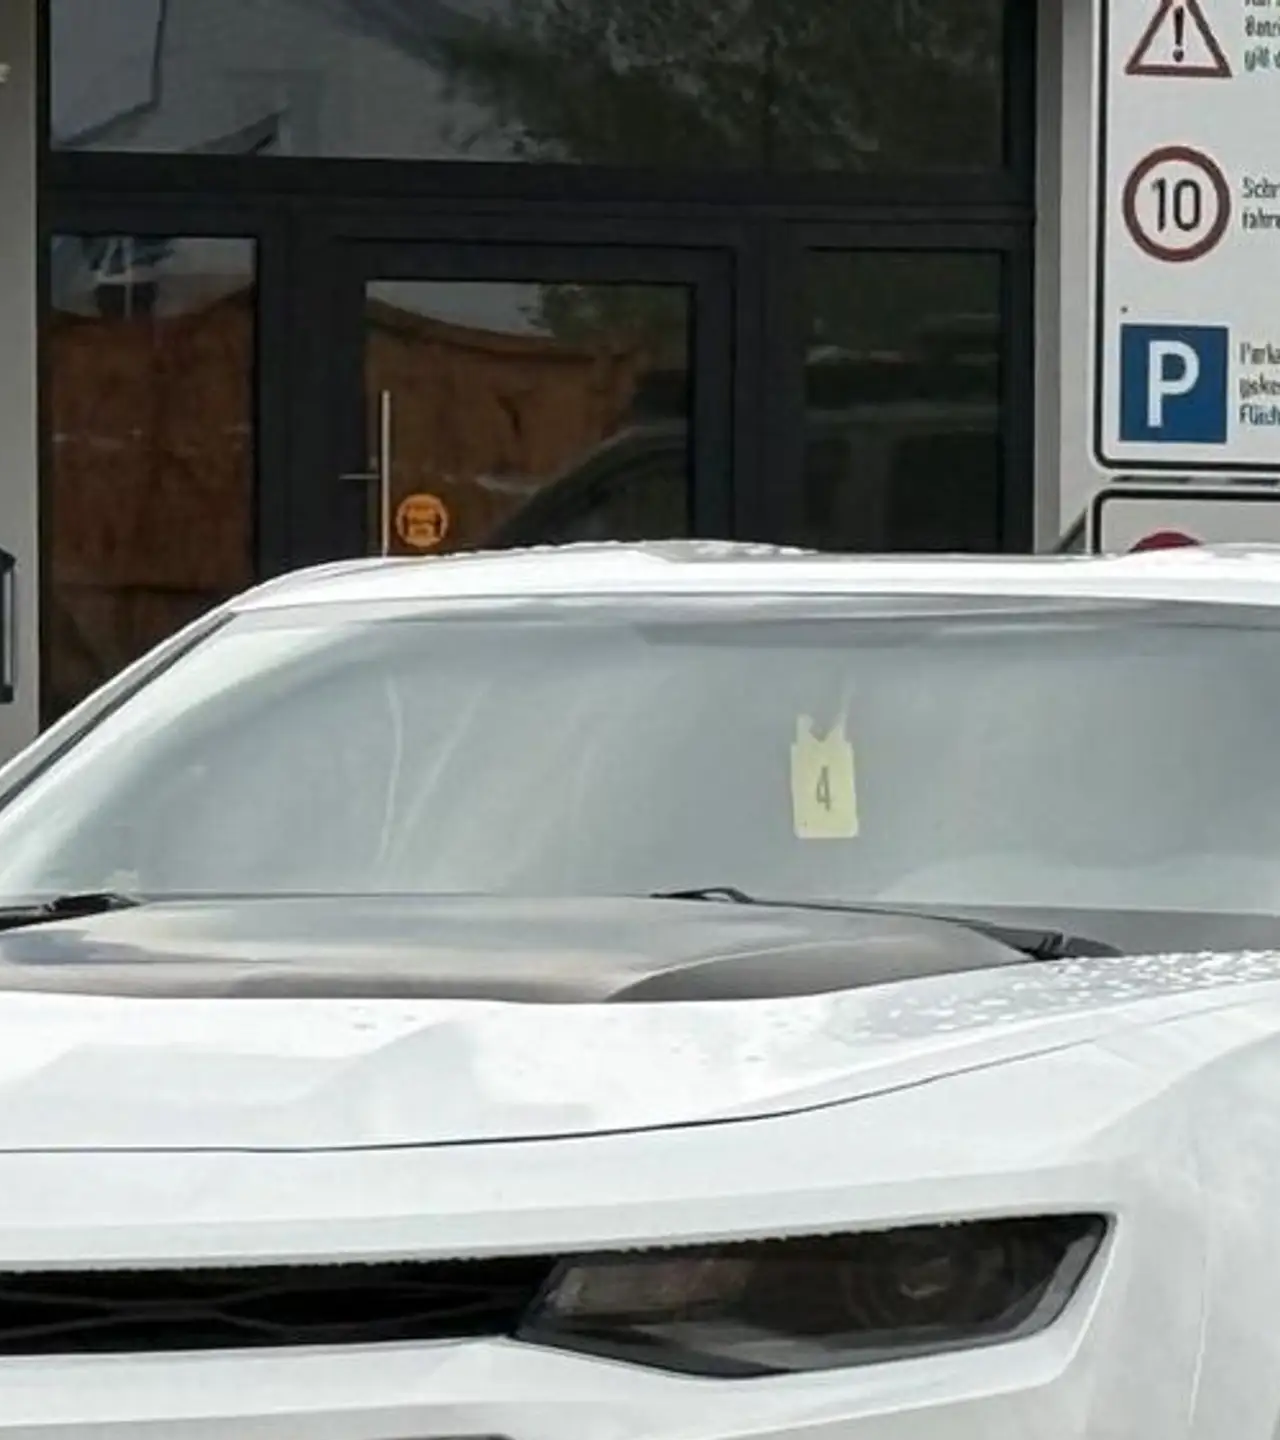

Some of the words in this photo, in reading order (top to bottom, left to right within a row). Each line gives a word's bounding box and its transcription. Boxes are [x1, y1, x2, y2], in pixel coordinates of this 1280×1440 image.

[1152, 177, 1201, 232] 10
[1148, 340, 1200, 427] P
[816, 765, 831, 812] 4
